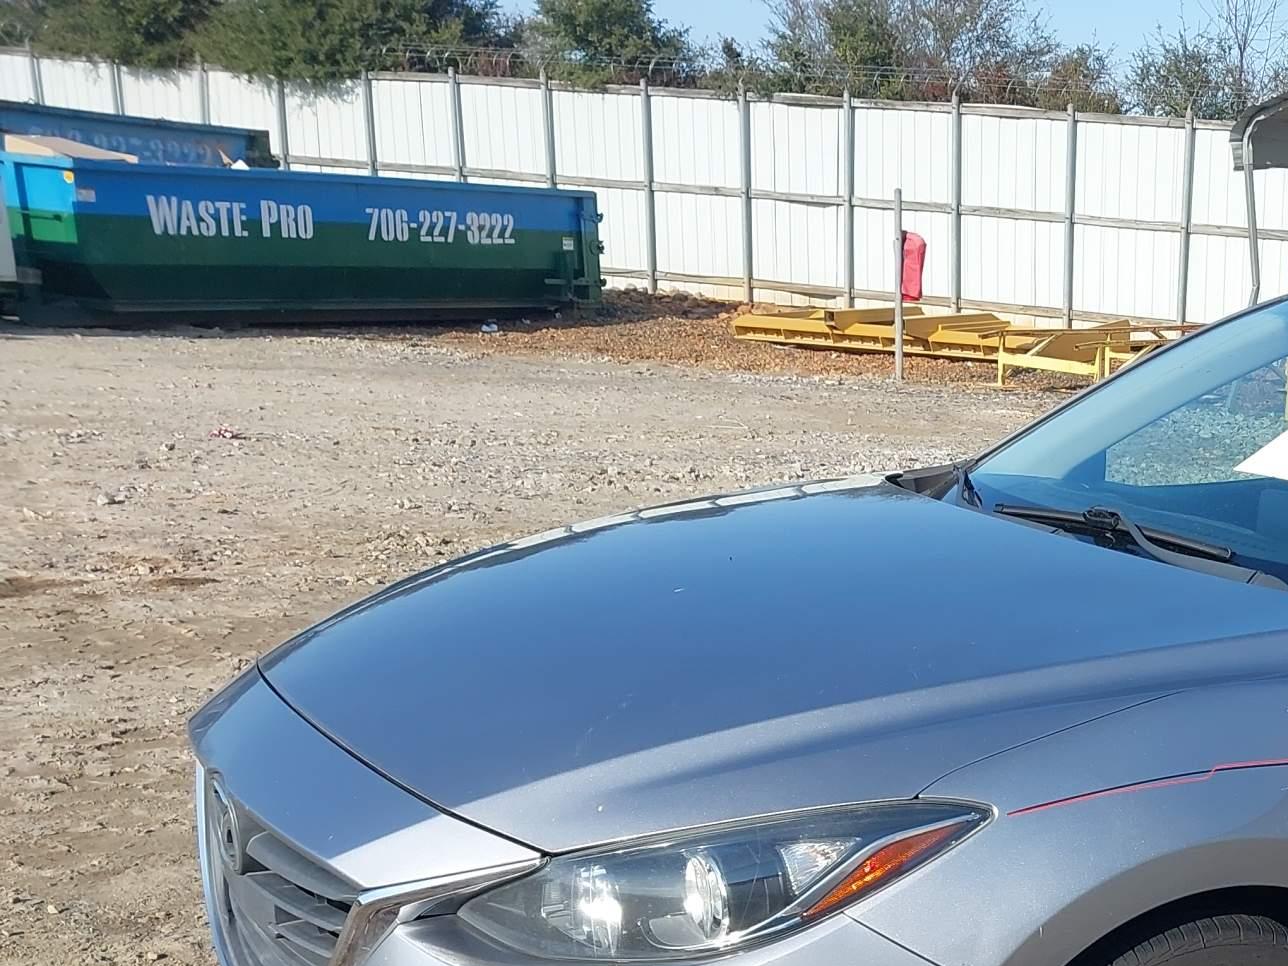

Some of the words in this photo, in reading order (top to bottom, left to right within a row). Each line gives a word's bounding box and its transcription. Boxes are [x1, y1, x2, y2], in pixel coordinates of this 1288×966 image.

[145, 195, 249, 239] WASTE
[261, 199, 314, 241] PRO
[364, 207, 516, 245] 706-227-3222
